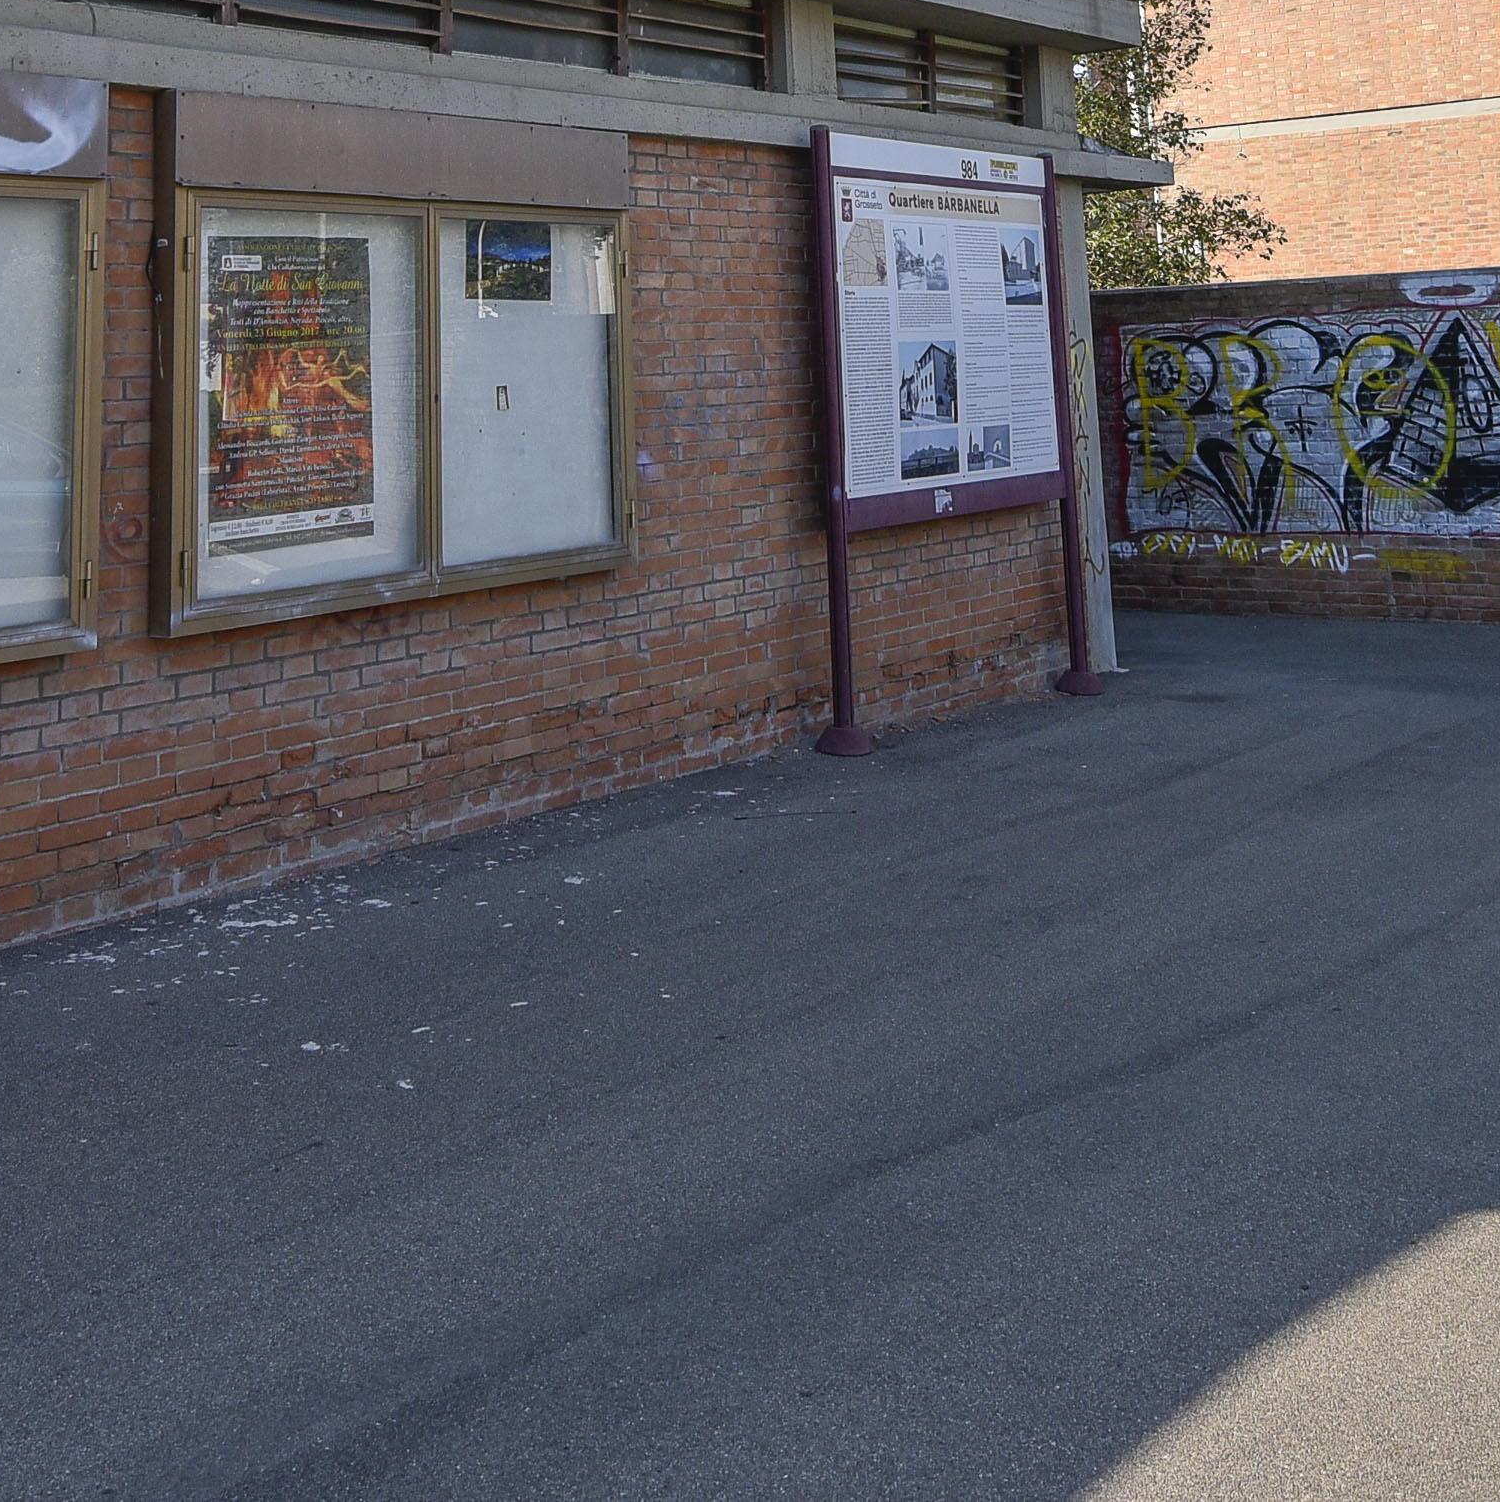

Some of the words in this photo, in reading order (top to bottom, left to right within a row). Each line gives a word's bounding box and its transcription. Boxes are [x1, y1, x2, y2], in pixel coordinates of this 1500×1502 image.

[961, 159, 978, 180] 984
[888, 192, 934, 210] Quartiere
[937, 196, 1001, 216] BARBANELLA
[215, 273, 238, 292] La
[240, 273, 276, 293] Notte
[277, 272, 288, 291] di
[292, 274, 312, 291] San
